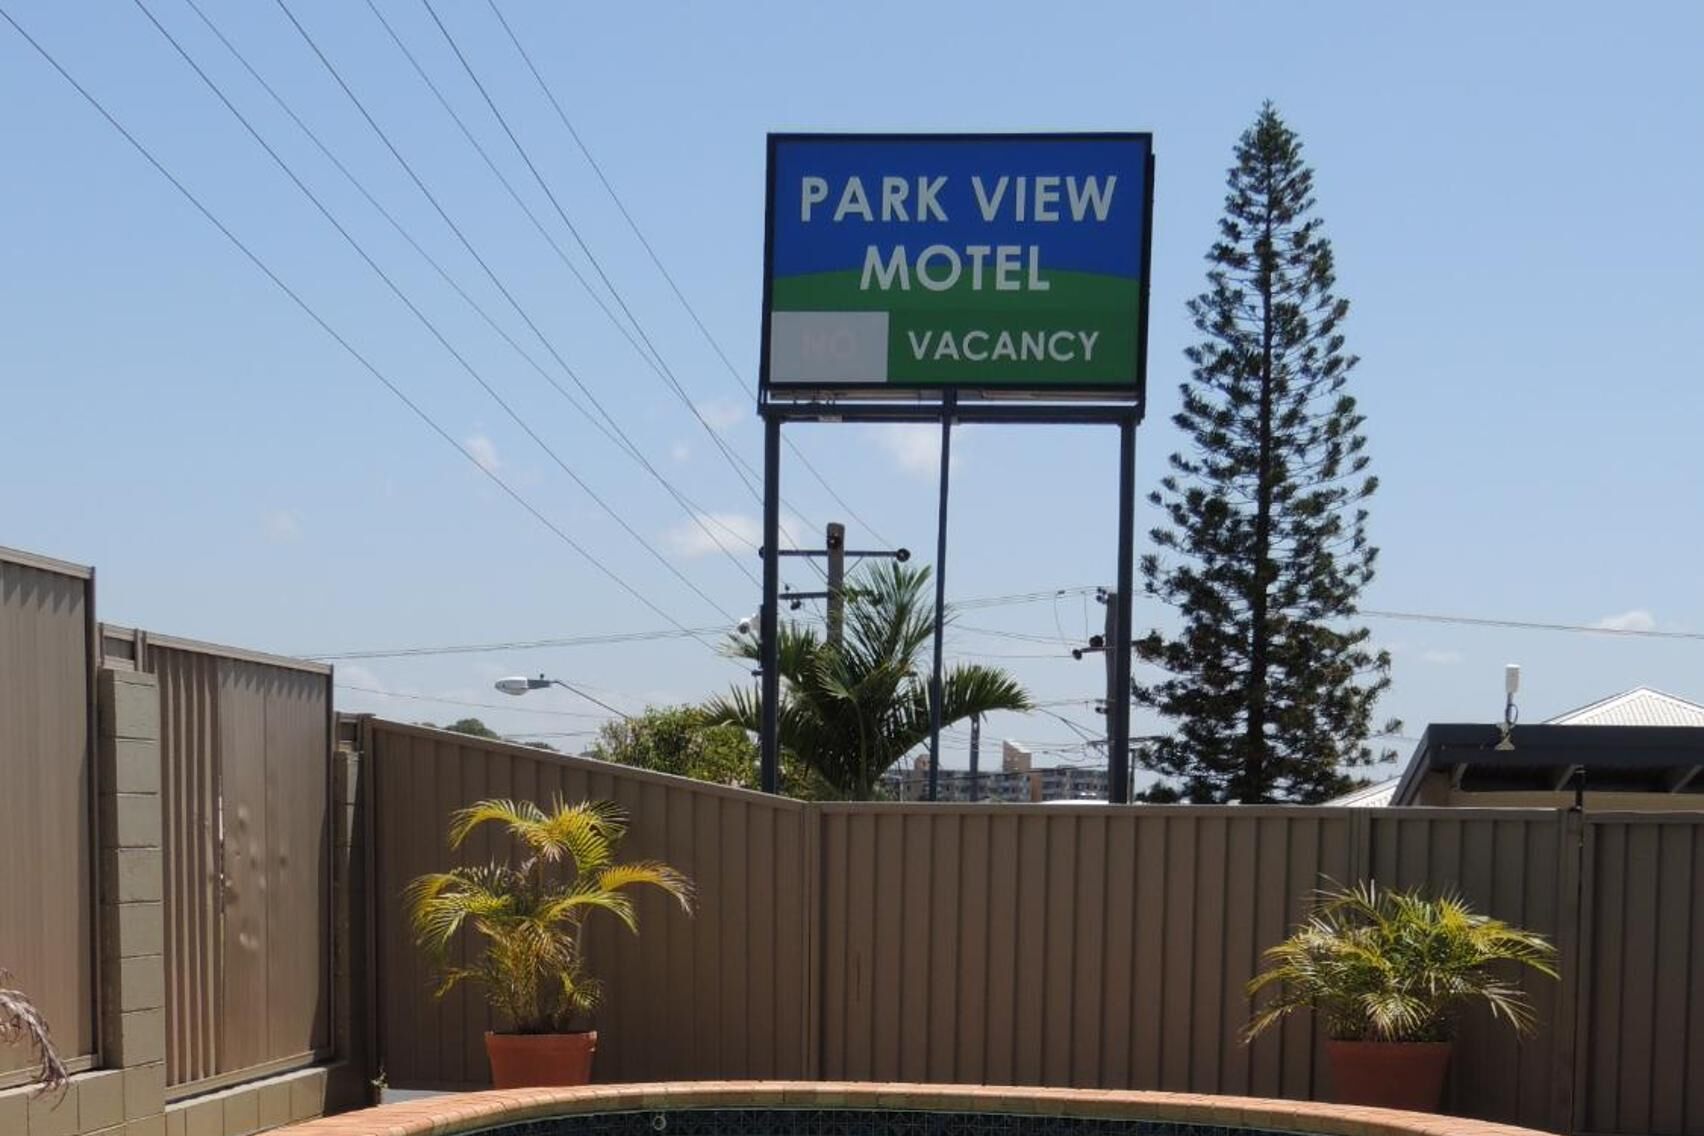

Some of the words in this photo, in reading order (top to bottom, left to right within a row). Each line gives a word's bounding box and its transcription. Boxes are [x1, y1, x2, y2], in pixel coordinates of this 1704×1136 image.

[801, 176, 949, 222] PARK
[971, 175, 1118, 222] VIEW
[859, 245, 1051, 292] MOTEL
[801, 328, 858, 360] NO
[908, 330, 1100, 361] VACANCY
